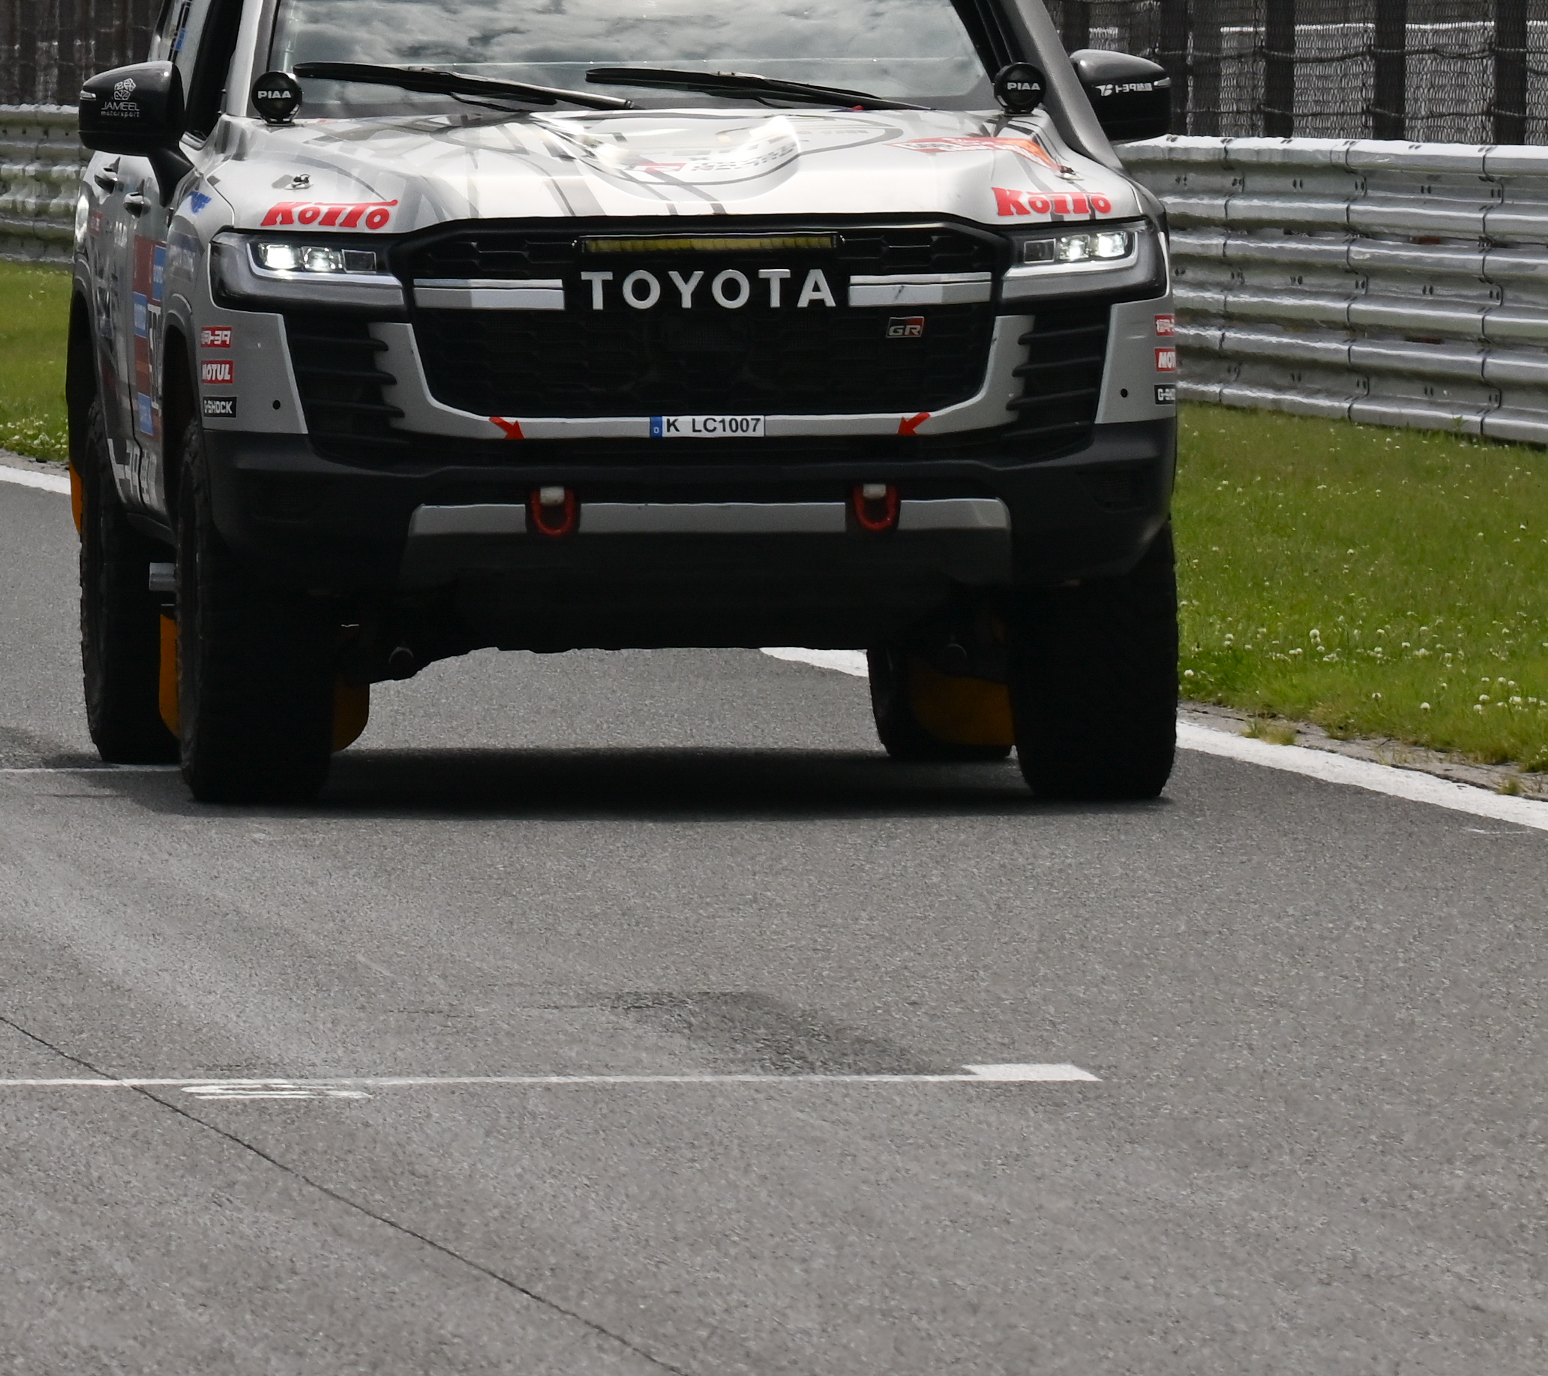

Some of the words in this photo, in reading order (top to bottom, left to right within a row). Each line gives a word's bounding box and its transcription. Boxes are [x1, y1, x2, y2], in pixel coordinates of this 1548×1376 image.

[1007, 82, 1041, 91] PIAA
[258, 90, 292, 99] PIAA
[101, 101, 140, 111] JAMEEL
[581, 269, 836, 310] TOYOTA
[888, 323, 922, 336] GR
[666, 418, 688, 433] K
[692, 417, 761, 433] LC1007
